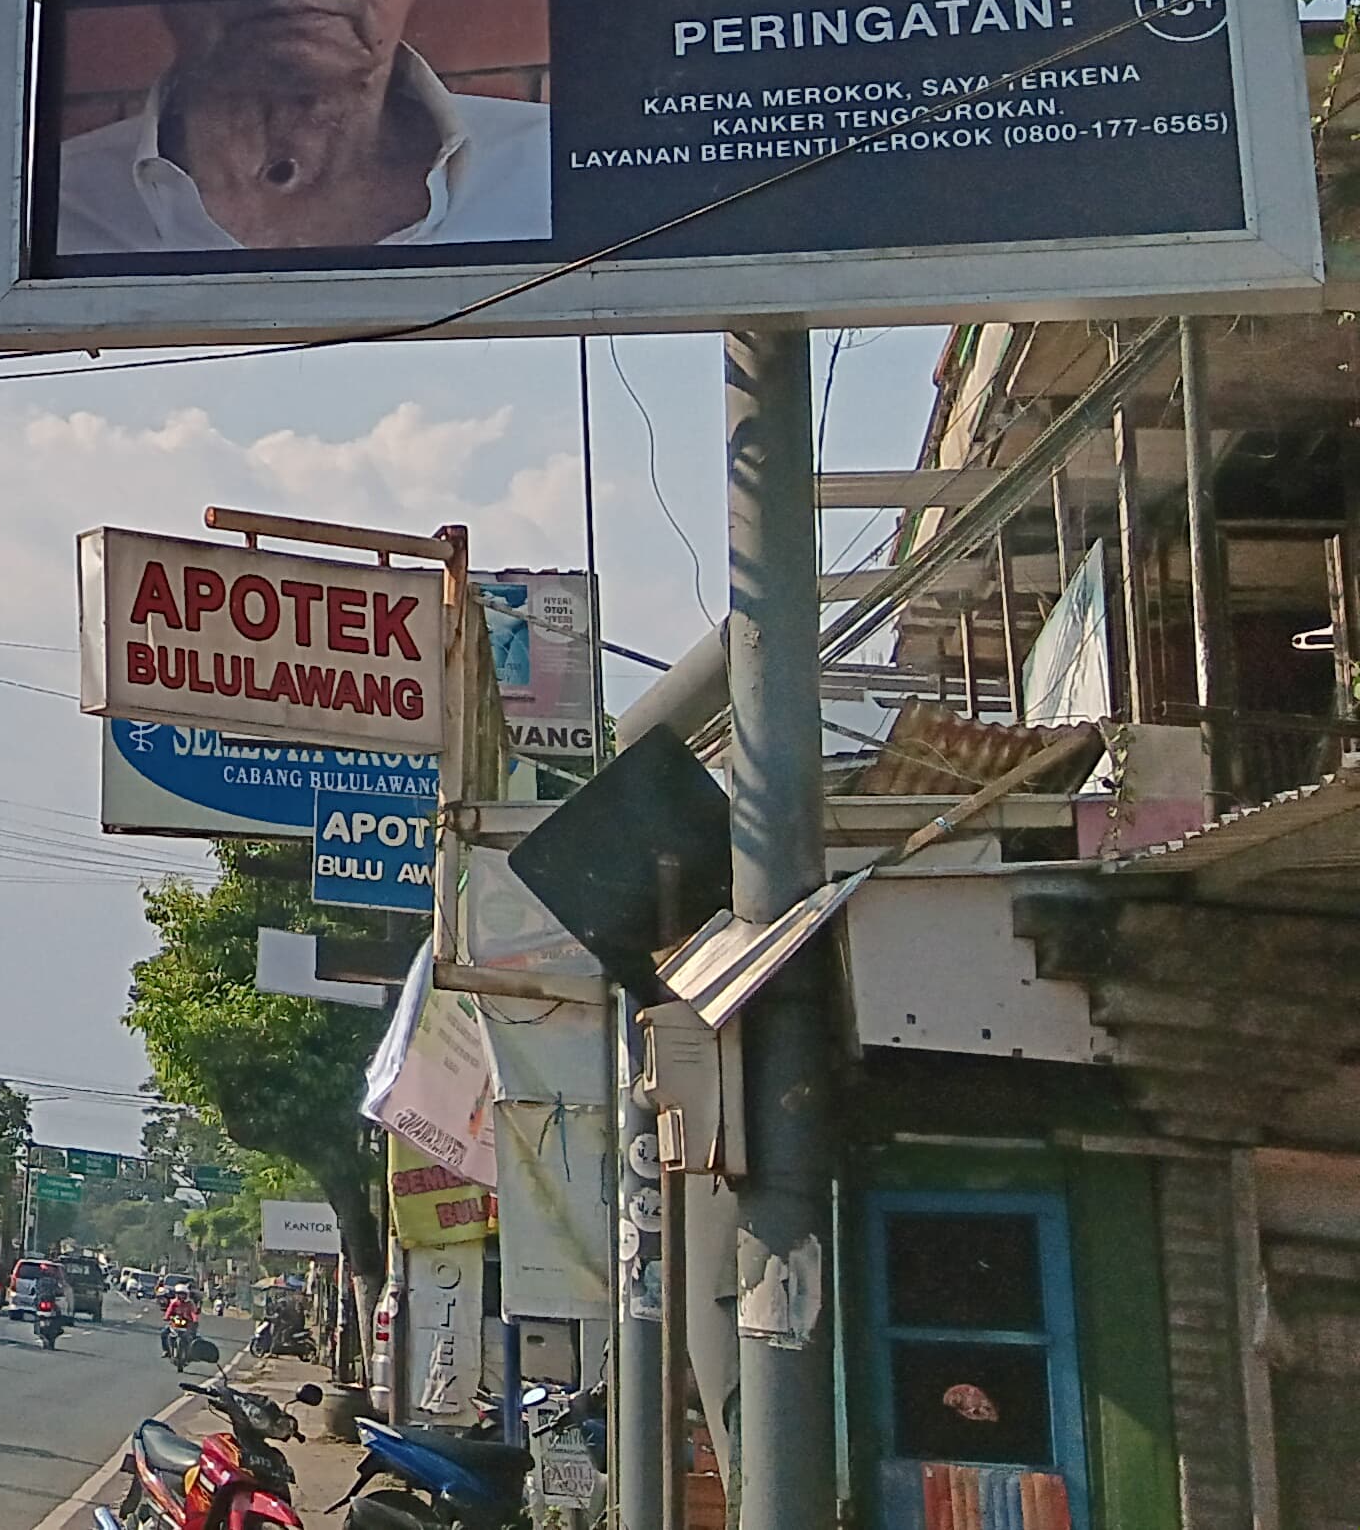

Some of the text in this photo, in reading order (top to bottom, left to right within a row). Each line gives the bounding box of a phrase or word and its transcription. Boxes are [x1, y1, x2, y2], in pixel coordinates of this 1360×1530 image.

[643, 64, 1141, 115] KARENA MEROKOK, SAYA TERKENA
[571, 144, 690, 169] LAYANAN
[701, 137, 838, 162] BERHENTI
[1003, 111, 1229, 149] (0800-177-6565)
[713, 113, 825, 136] KANKER
[129, 560, 422, 661] APOTEK
[126, 640, 424, 721] BULULAWANG
[223, 765, 303, 788] CABANG
[284, 1221, 332, 1233] KANTOR
